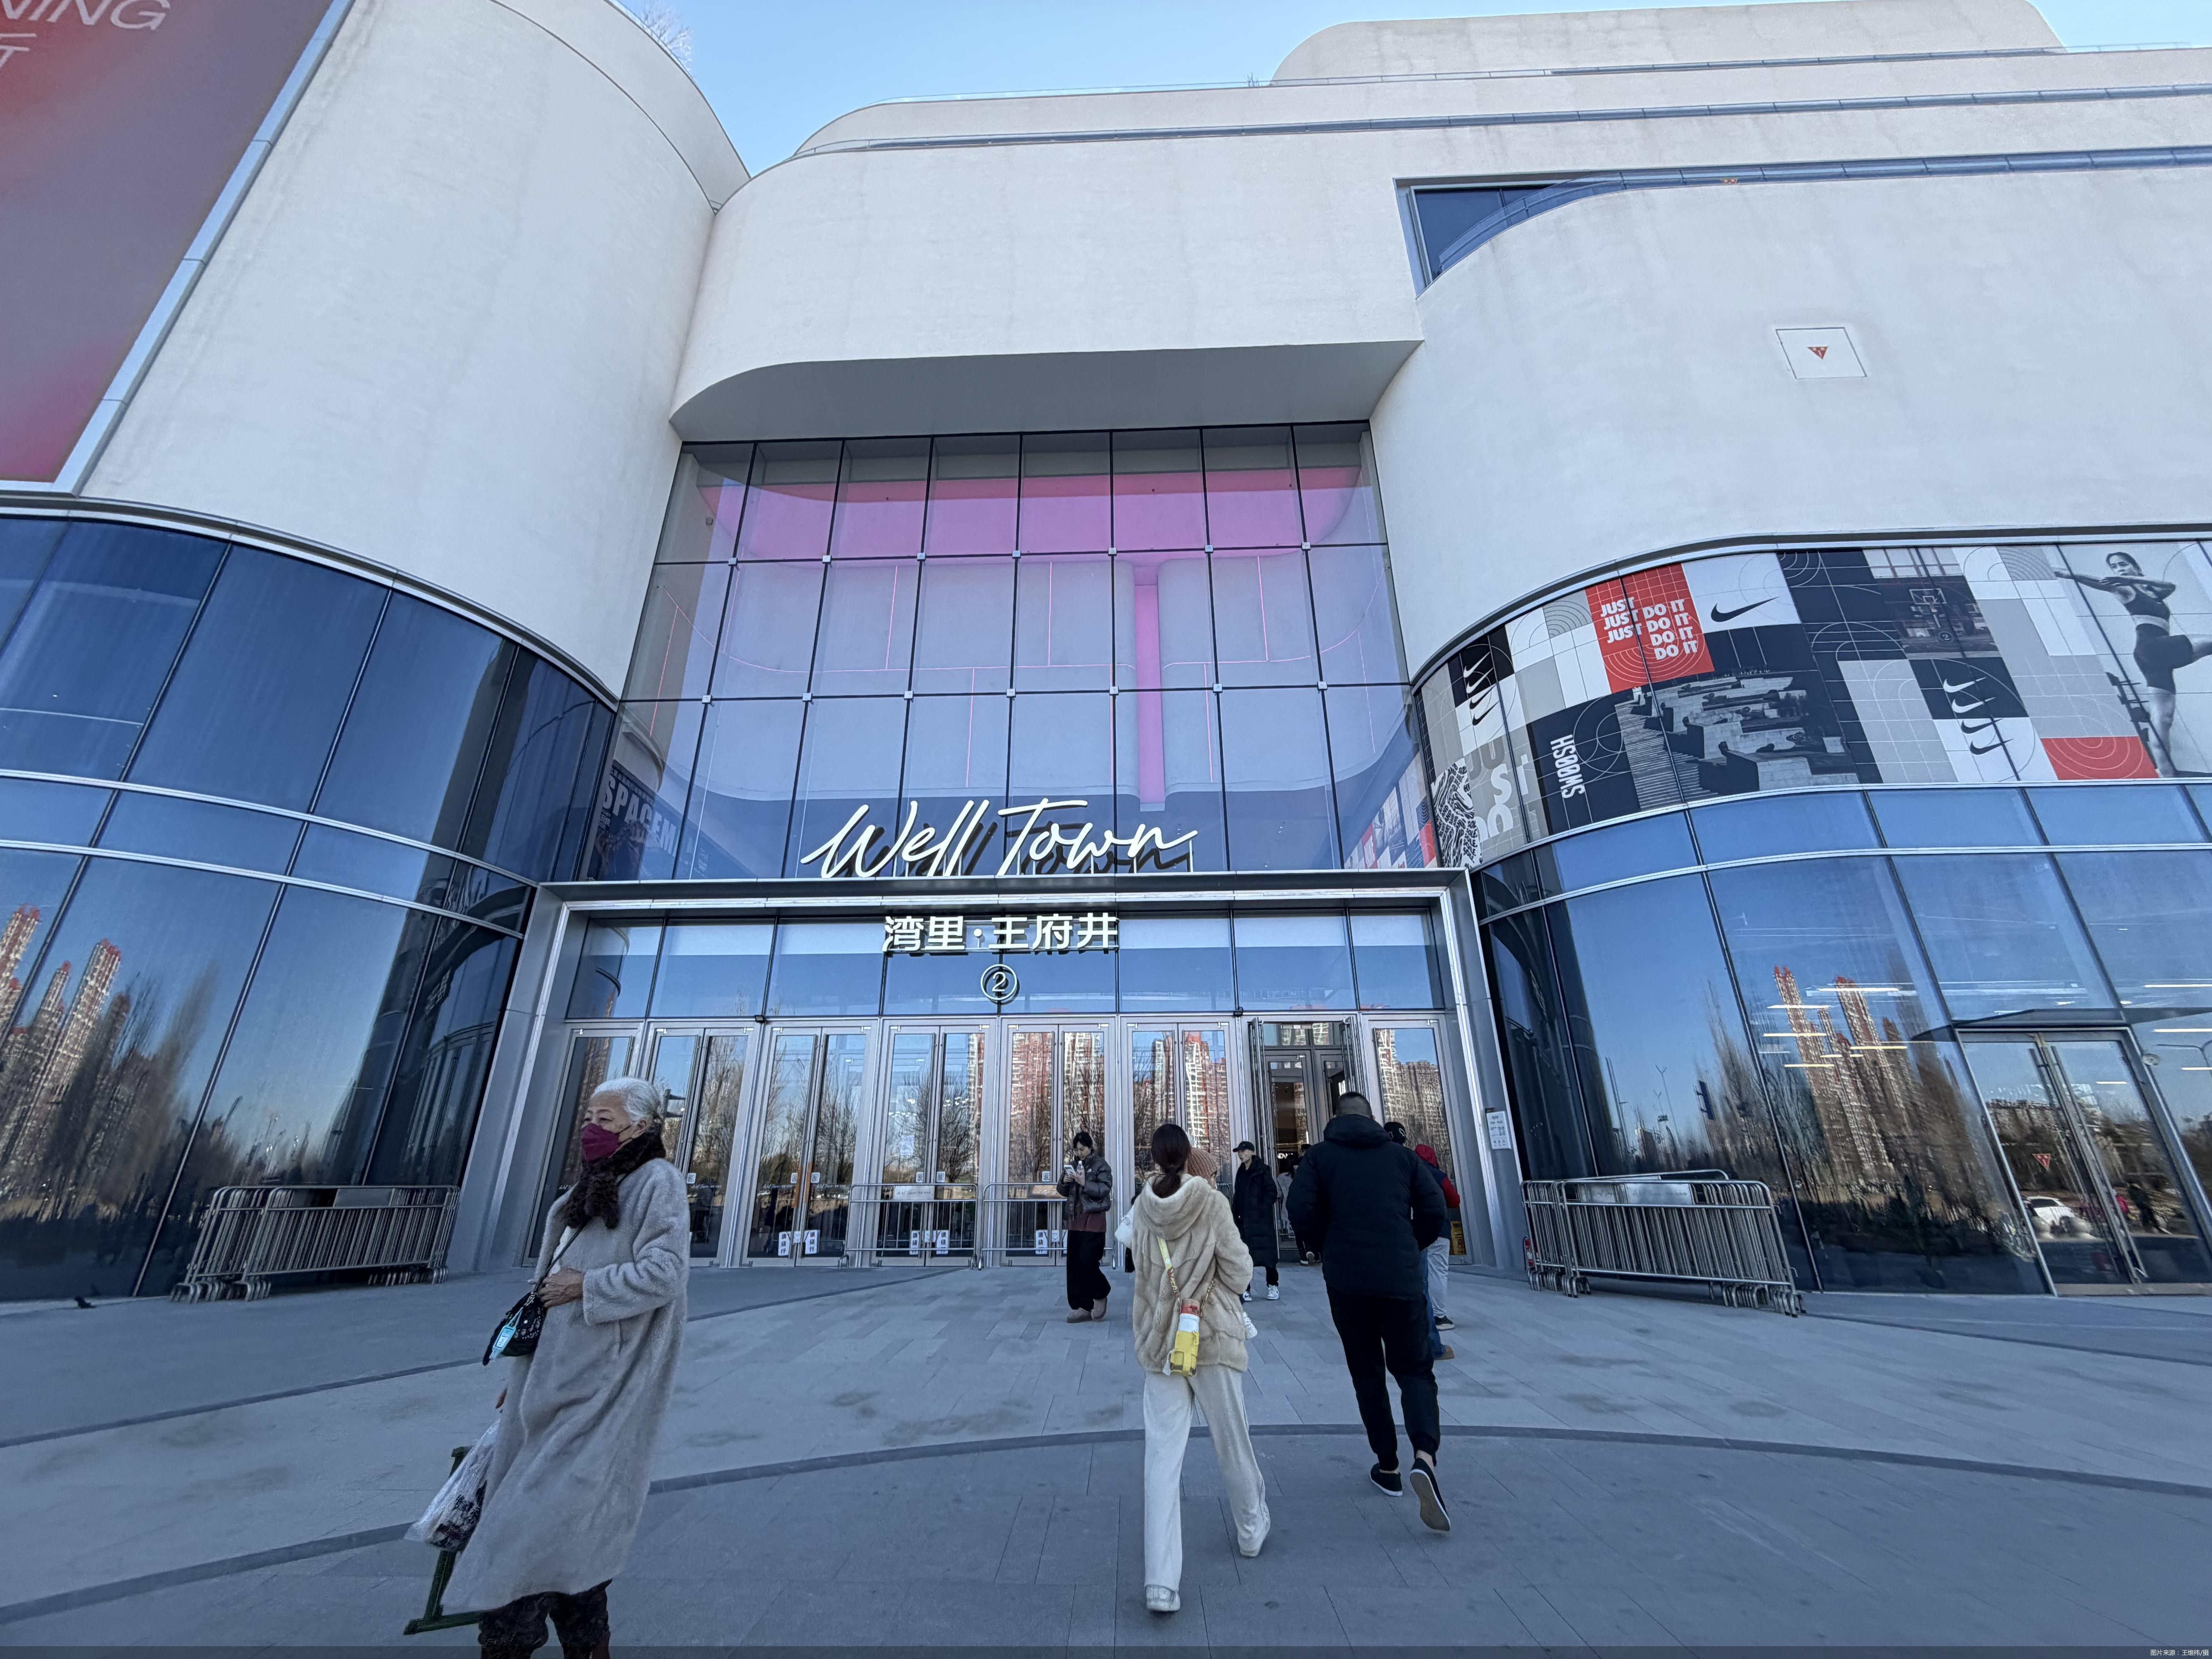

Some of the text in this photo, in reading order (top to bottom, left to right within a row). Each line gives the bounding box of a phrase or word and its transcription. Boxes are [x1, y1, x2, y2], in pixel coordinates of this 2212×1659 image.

[1601, 597, 1635, 617] JUST
[1604, 599, 1685, 630] JUST DO IT
[1607, 613, 1689, 643] JUST DO IT
[1650, 626, 1693, 646] DO IT
[1654, 640, 1697, 660] DO IT
[800, 798, 1198, 879] Well Town
[882, 912, 1118, 952] 湾里·王府井
